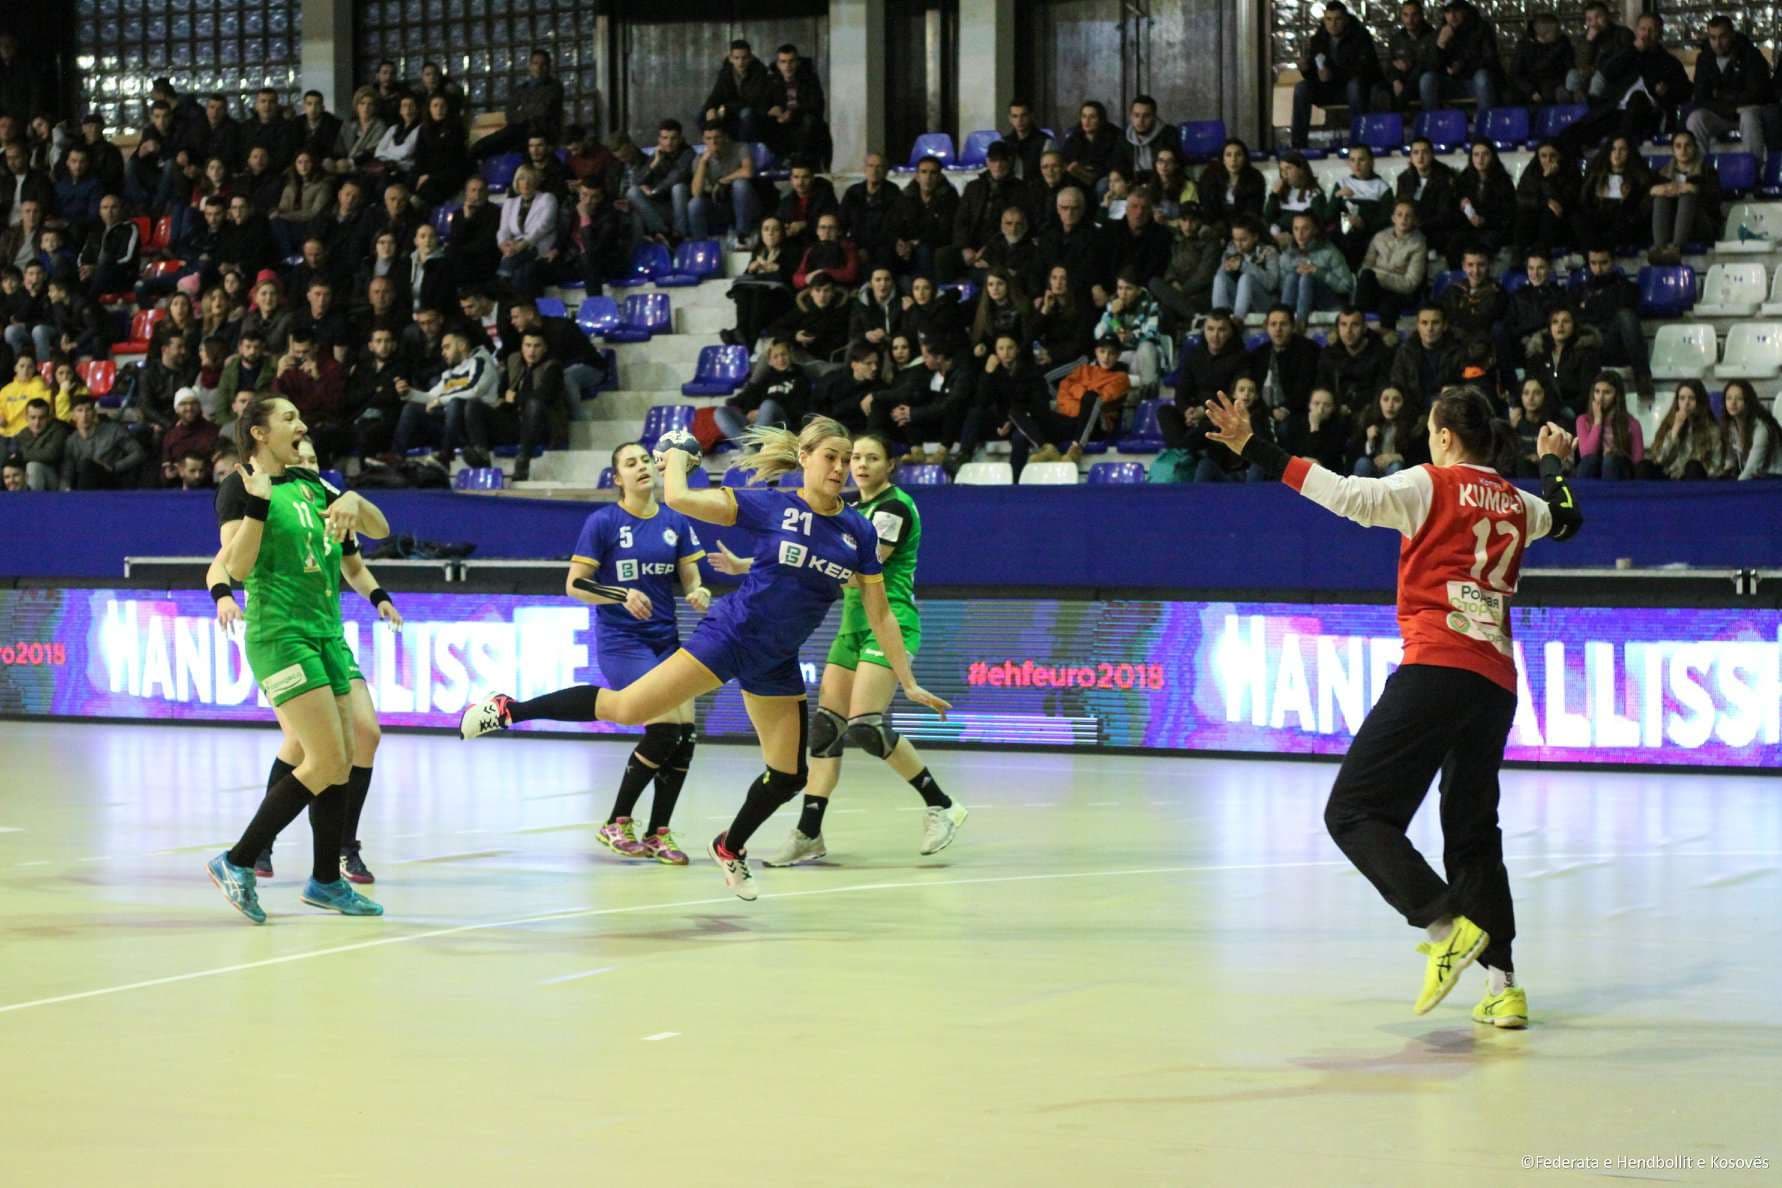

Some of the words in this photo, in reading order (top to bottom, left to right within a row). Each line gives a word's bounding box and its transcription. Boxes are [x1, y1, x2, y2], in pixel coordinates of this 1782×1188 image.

[781, 507, 813, 536] 21
[620, 525, 633, 548] 5
[808, 555, 854, 580] KEP
[1470, 516, 1520, 592] 12
[641, 562, 675, 575] KEP
[968, 657, 1166, 690] #ehfeuro2018
